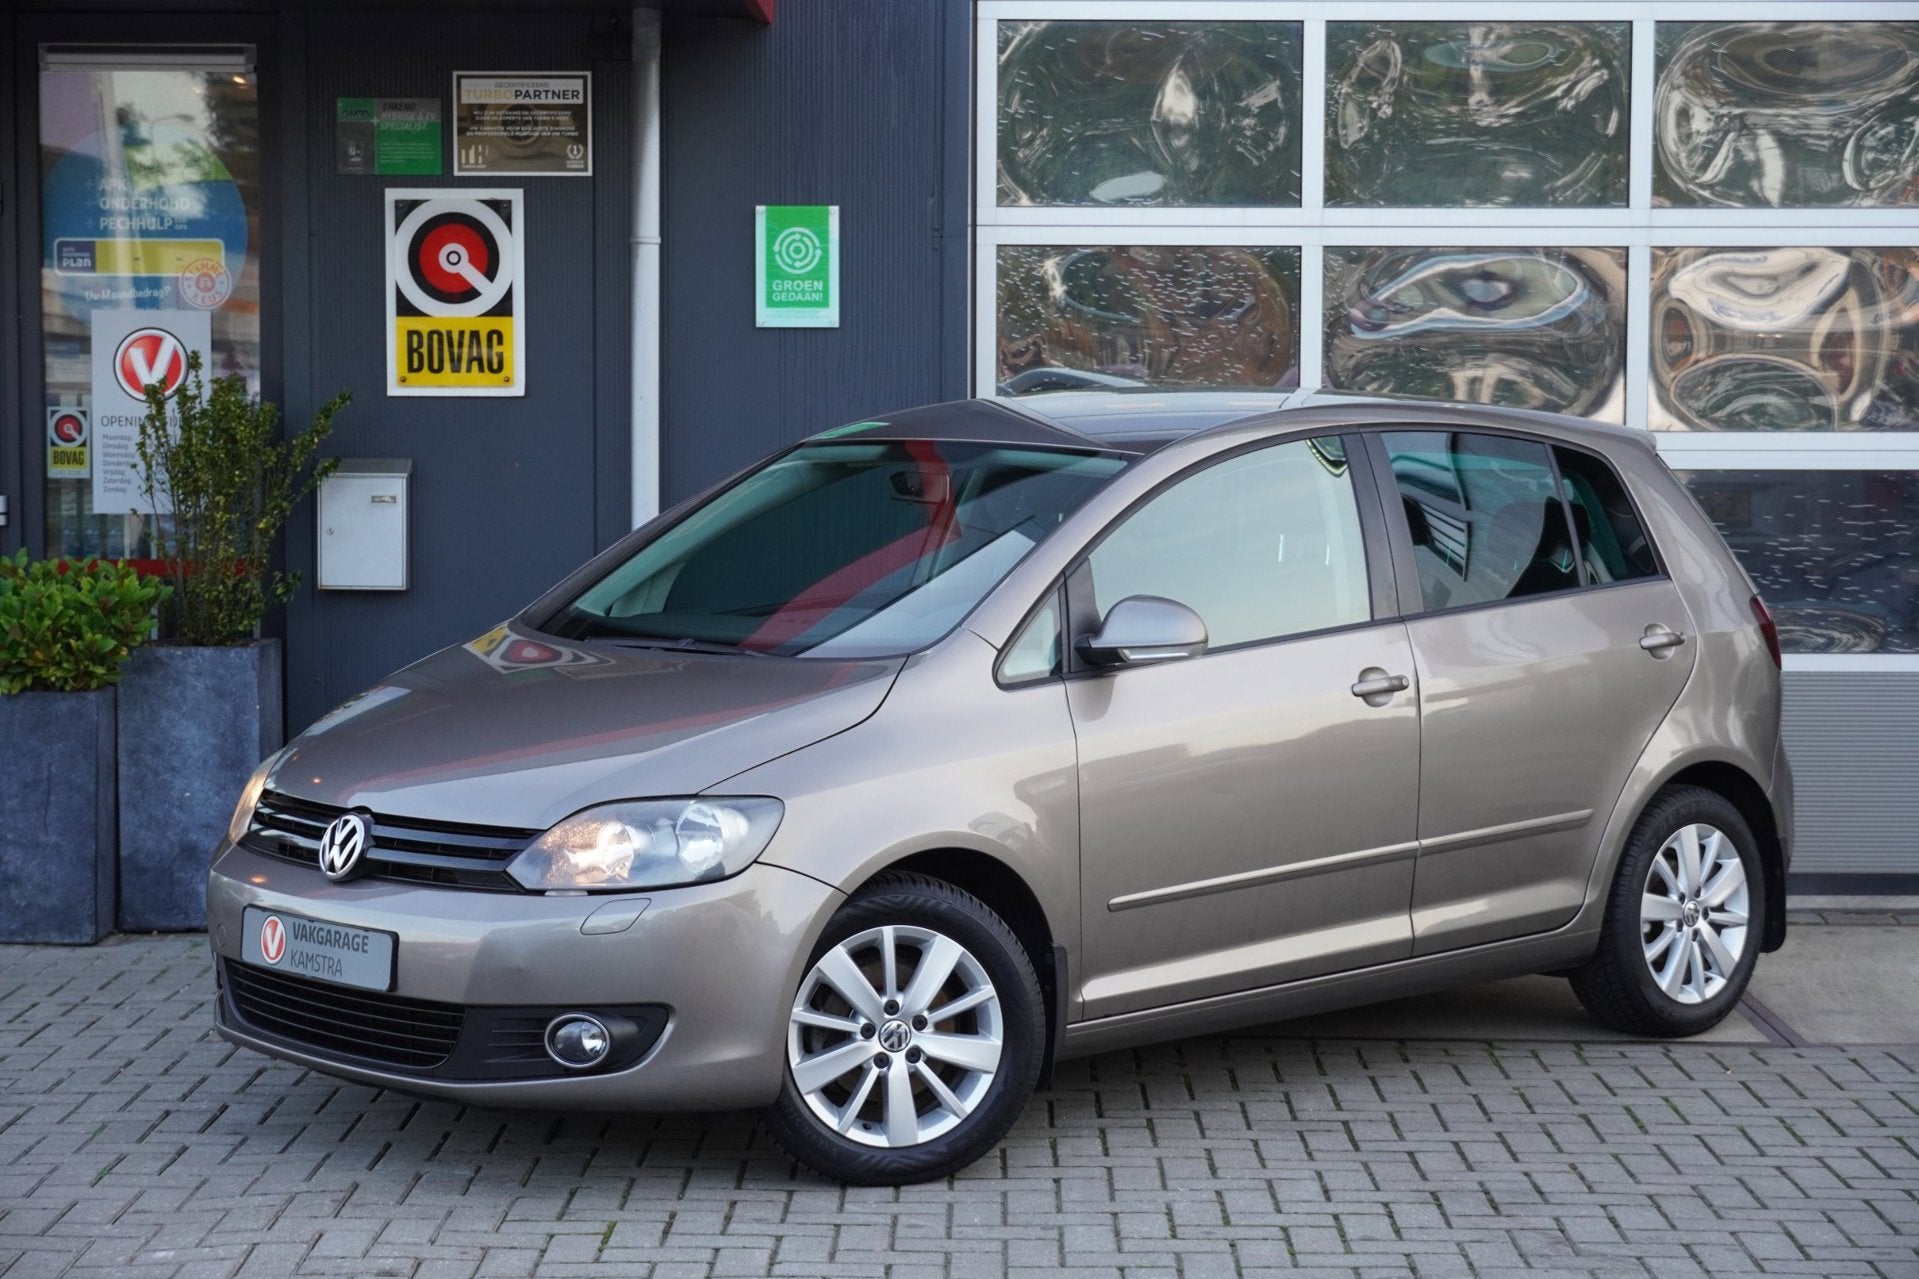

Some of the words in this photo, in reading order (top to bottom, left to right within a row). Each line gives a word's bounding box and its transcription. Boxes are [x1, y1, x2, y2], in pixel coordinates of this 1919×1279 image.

[464, 89, 580, 100] TURBOPARTNER
[100, 197, 190, 210] ONDERHOUD
[100, 217, 172, 230] PECHHULP
[772, 280, 823, 291] GROEN
[772, 292, 823, 302] GEDAAN!
[407, 329, 504, 374] BOVAG
[53, 451, 84, 465] BOVAG
[292, 921, 369, 953] VAKGARAGE
[290, 949, 343, 977] KAMSTRA
